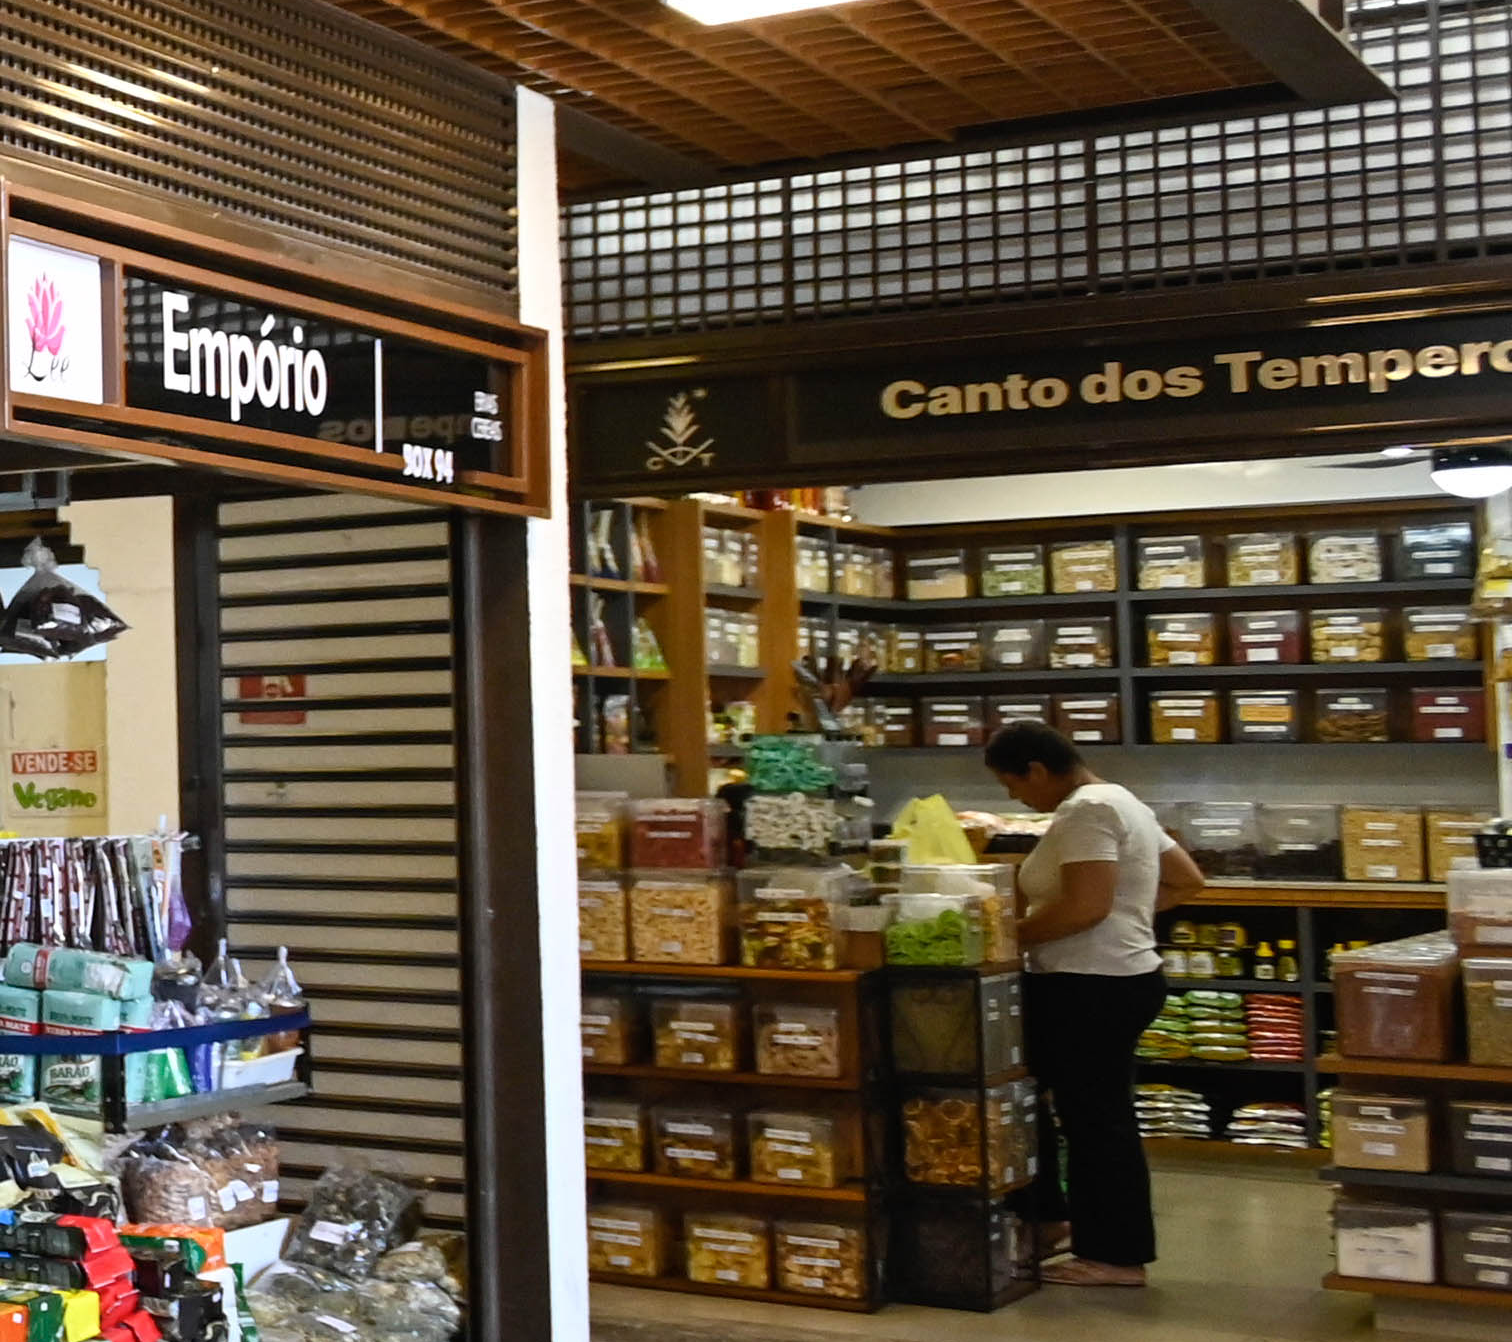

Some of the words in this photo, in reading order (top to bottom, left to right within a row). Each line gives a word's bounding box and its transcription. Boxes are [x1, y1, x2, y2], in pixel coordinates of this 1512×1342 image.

[163, 290, 328, 421] Empório
[881, 371, 1070, 420] Canto
[1080, 363, 1205, 405] dos
[13, 752, 97, 774] VENDE-SE
[13, 782, 98, 811] Vegano
